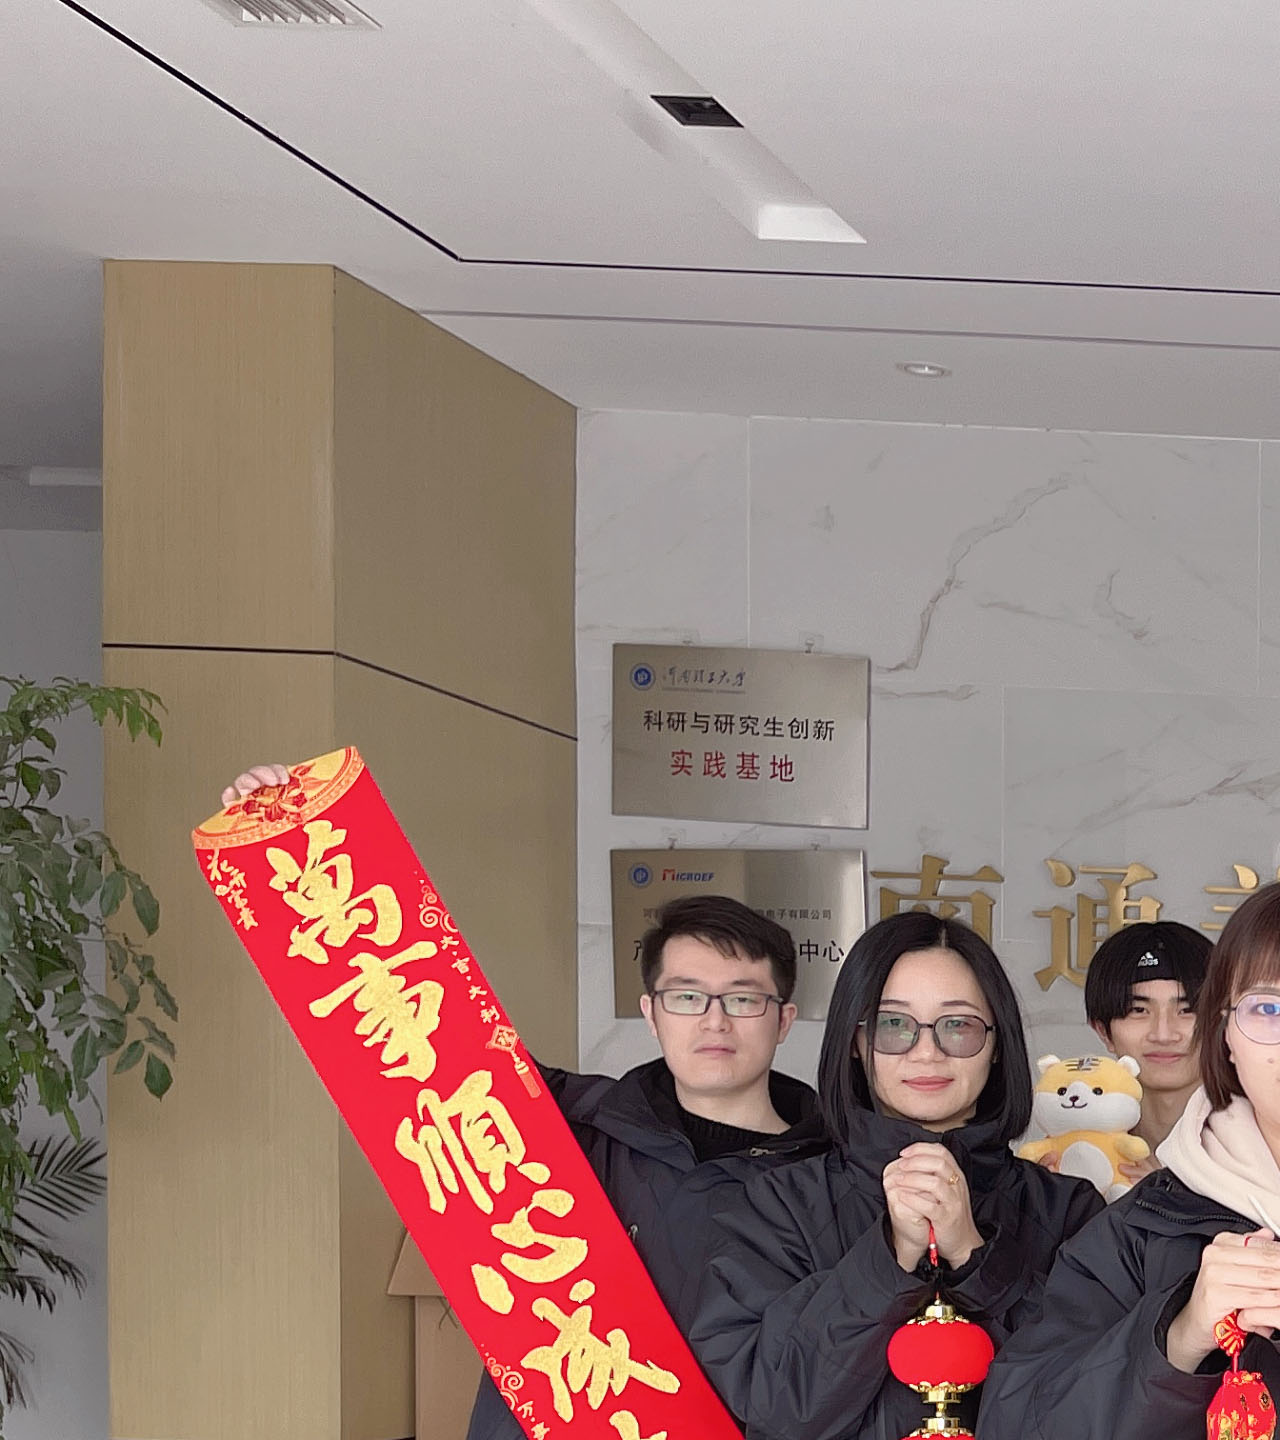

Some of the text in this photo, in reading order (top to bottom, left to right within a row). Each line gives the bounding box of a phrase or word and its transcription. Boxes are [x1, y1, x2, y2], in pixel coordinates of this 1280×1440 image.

[643, 709, 836, 741] 科研与研究生创新
[671, 750, 796, 783] 实践基地
